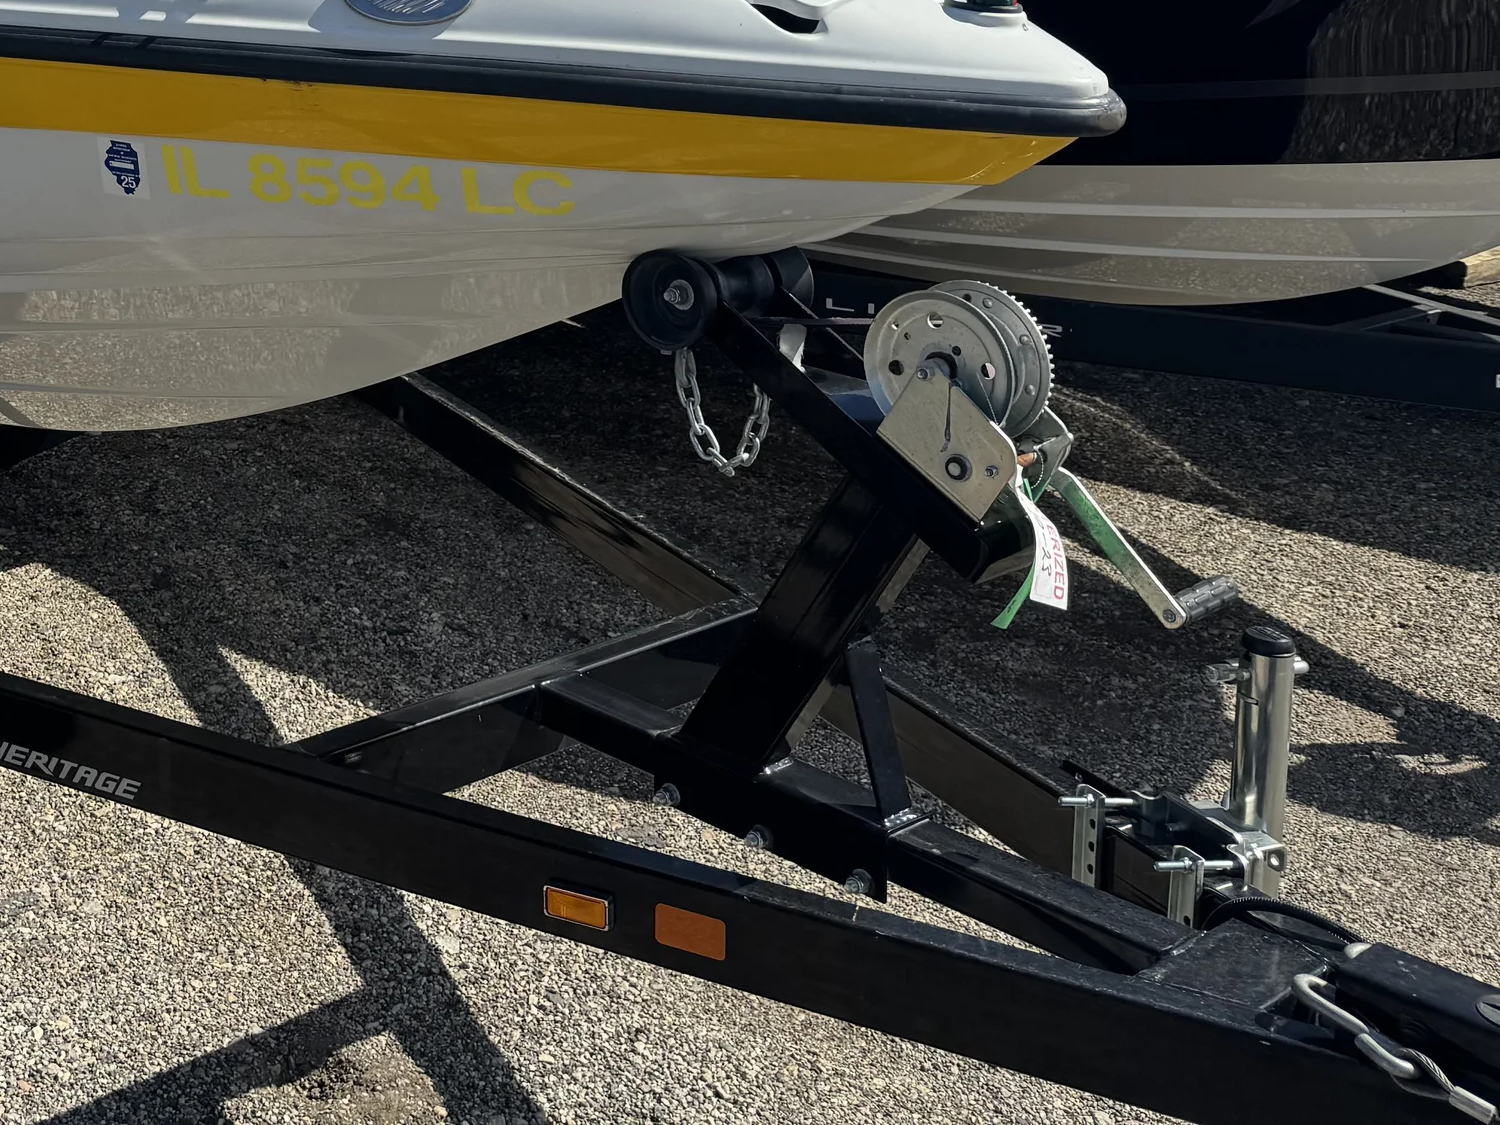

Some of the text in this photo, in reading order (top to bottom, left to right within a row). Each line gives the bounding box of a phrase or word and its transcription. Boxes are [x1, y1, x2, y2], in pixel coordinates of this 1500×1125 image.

[120, 175, 137, 189] 25
[161, 143, 576, 216] IL 8594 LC
